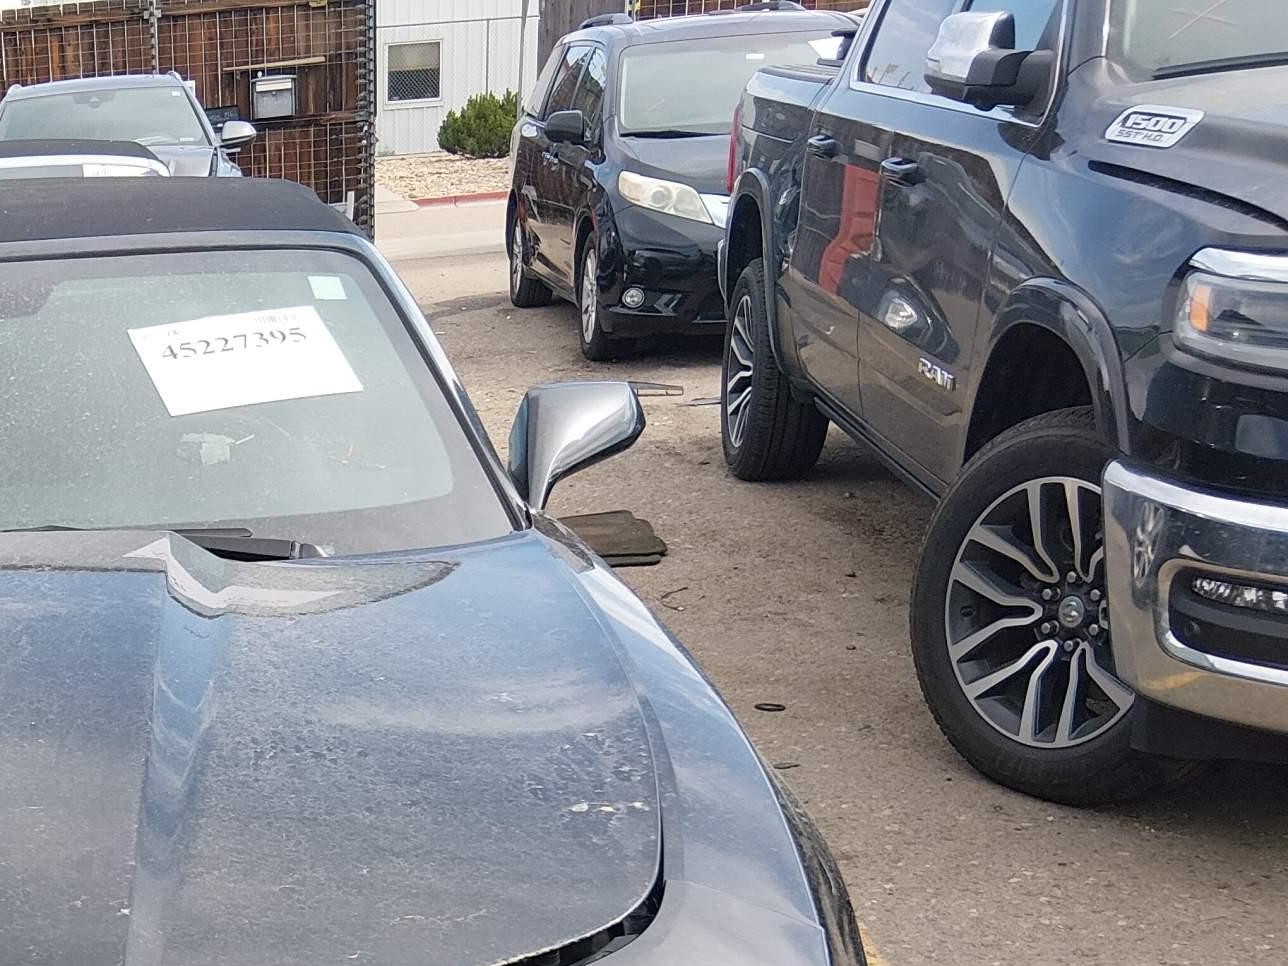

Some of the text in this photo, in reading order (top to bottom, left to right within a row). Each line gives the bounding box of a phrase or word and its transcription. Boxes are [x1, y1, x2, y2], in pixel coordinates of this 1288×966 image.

[1123, 112, 1186, 134] 1500
[162, 327, 307, 360] 45227395
[918, 357, 957, 391] RAM
